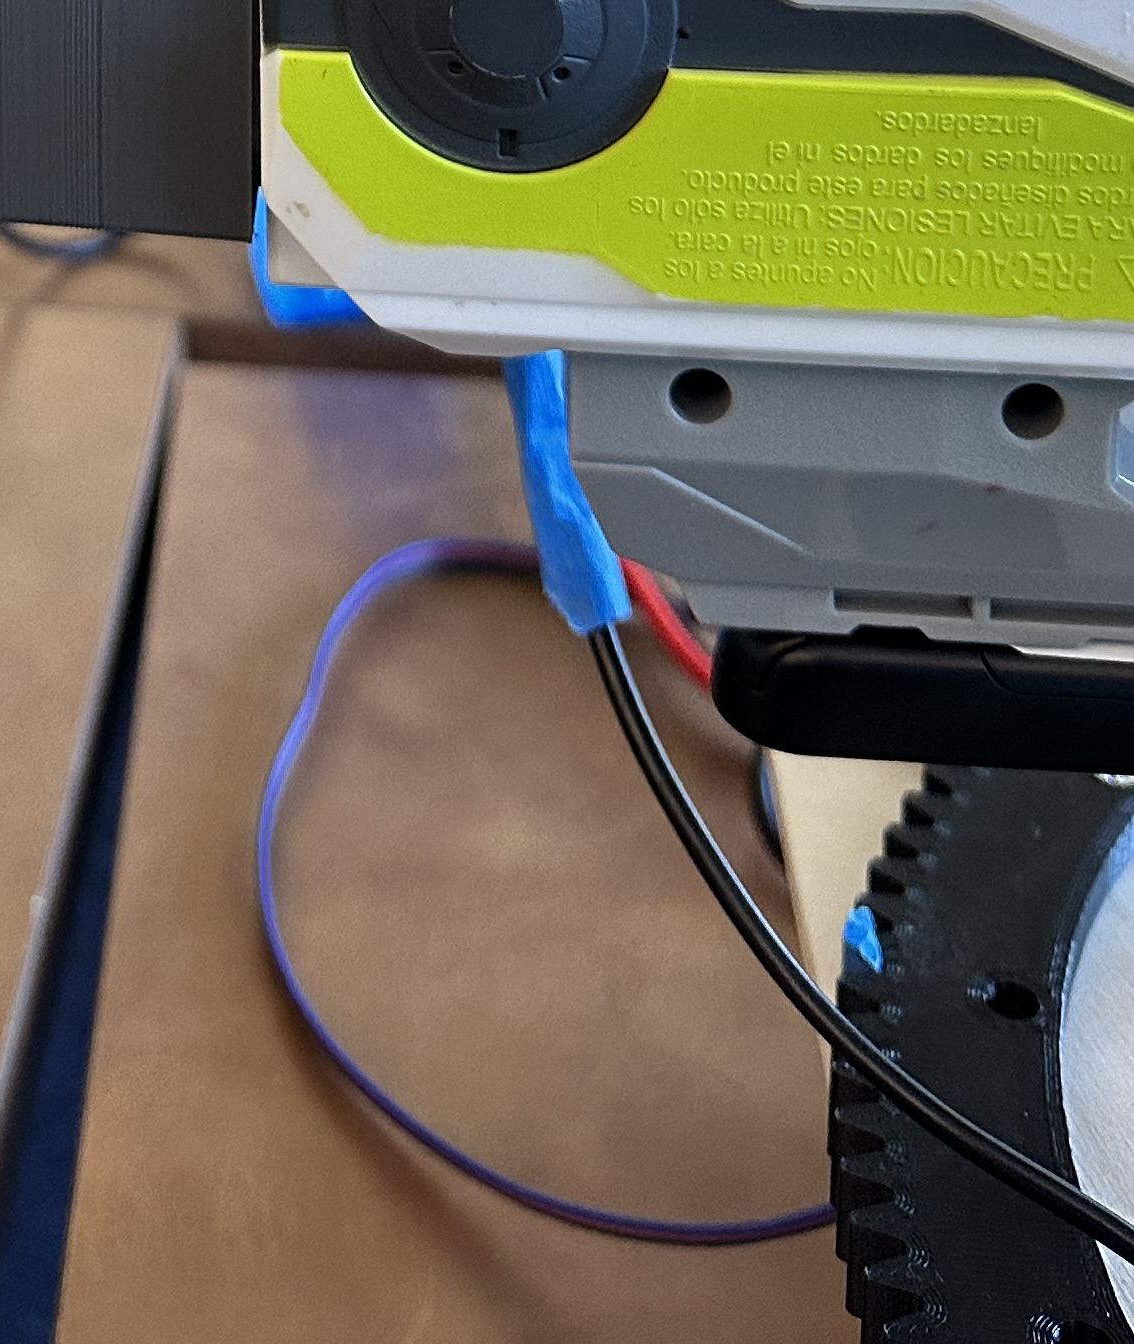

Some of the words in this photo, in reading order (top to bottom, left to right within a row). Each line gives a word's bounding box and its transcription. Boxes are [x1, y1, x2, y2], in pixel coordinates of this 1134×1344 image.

[874, 111, 1040, 143] lanzadardos.
[768, 141, 789, 168] el
[797, 142, 819, 167] ni
[832, 144, 919, 172] dardos
[933, 148, 973, 175] los
[982, 146, 1123, 178] modifiques
[682, 169, 798, 197] producto.
[807, 175, 861, 200] este
[869, 176, 925, 201] para
[935, 182, 1067, 210] diseñados
[628, 196, 664, 223] los
[733, 202, 811, 230] Utiliza
[819, 206, 968, 236] LESIONES:
[978, 212, 1079, 241] EVITAR
[669, 232, 728, 254] cara.
[740, 235, 761, 260] la
[770, 236, 786, 256] a
[795, 238, 816, 262] ni
[824, 234, 876, 262] ojos
[663, 258, 701, 284] los
[707, 261, 722, 280] a
[730, 260, 831, 287] apuntes
[840, 267, 875, 293] No
